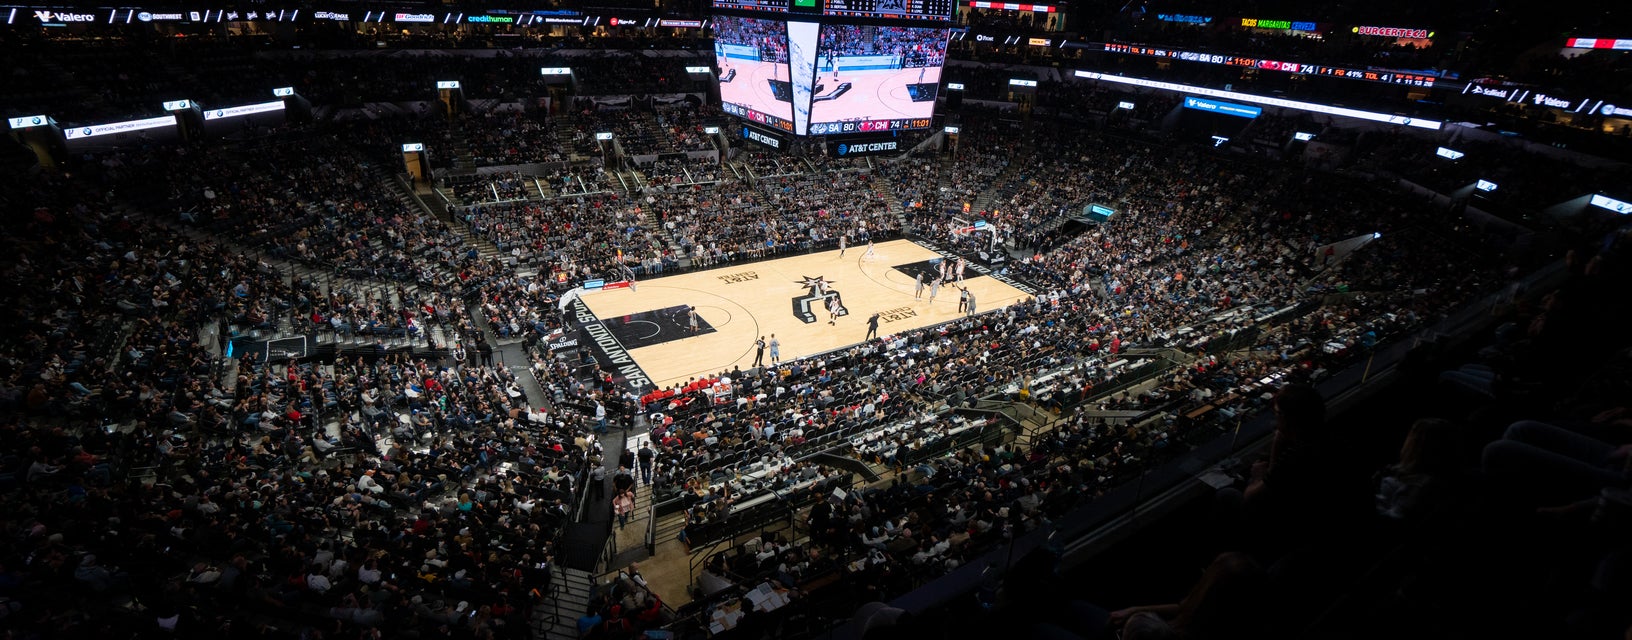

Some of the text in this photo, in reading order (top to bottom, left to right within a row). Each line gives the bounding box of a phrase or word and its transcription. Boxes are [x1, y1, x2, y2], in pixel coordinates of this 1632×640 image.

[54, 12, 95, 22] Valero
[1242, 18, 1316, 30] TACOS MARGARITAS CERVEZA
[1359, 26, 1426, 38] BURGERTECA
[1234, 58, 1255, 66] 11:01
[1281, 63, 1297, 71] CHI
[1301, 65, 1313, 73] 74
[1197, 101, 1216, 109] Valero
[1544, 97, 1570, 108] Valero
[766, 116, 772, 124] 74
[749, 130, 779, 148] AT&T CENTER
[849, 142, 896, 153] AT&T CENTER
[882, 310, 918, 323] AT&T
[550, 339, 578, 350] SPALDING
[584, 323, 633, 364] ANTONIO
[618, 364, 650, 387] SAN
